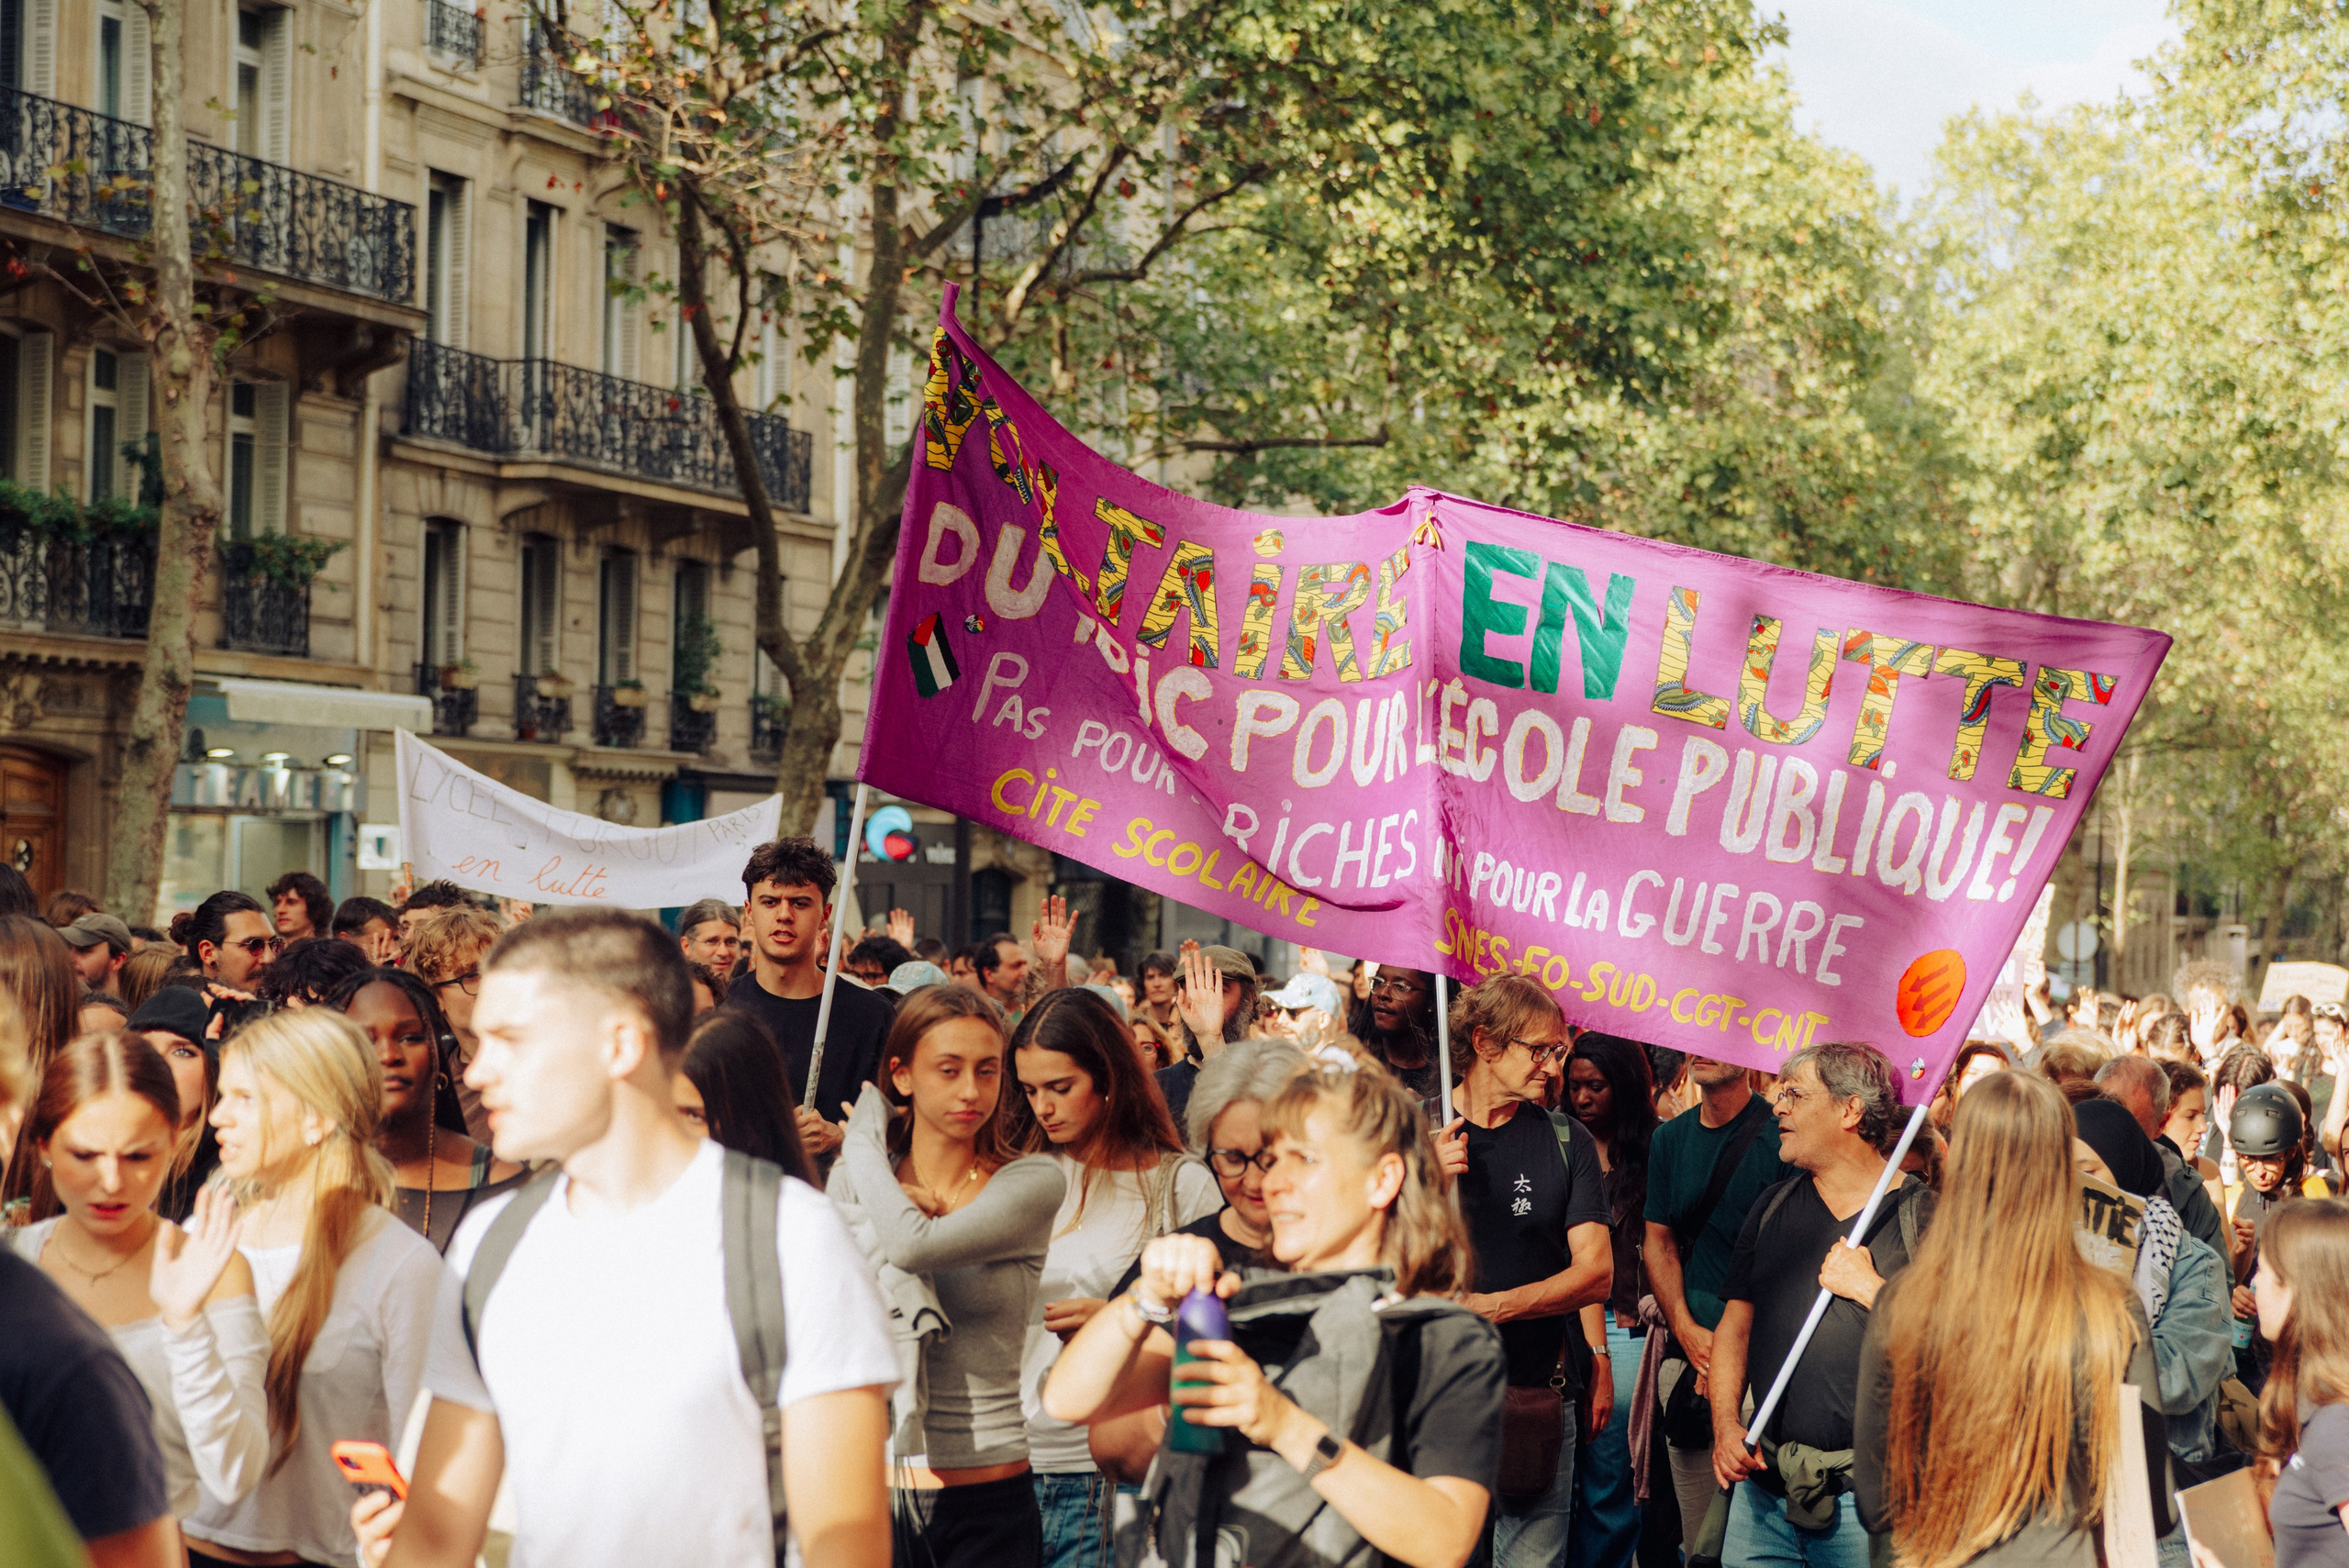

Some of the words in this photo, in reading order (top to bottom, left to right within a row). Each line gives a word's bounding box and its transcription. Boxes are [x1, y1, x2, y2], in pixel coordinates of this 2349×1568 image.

[918, 501, 1057, 620] DU
[1230, 690, 1408, 789] POUR
[1459, 539, 1636, 701] EN
[1652, 585, 2118, 800] LUTTE
[451, 855, 503, 883] en
[527, 855, 609, 899] lutte
[1469, 851, 1562, 923] POUR
[1617, 869, 1865, 986] GUERRE
